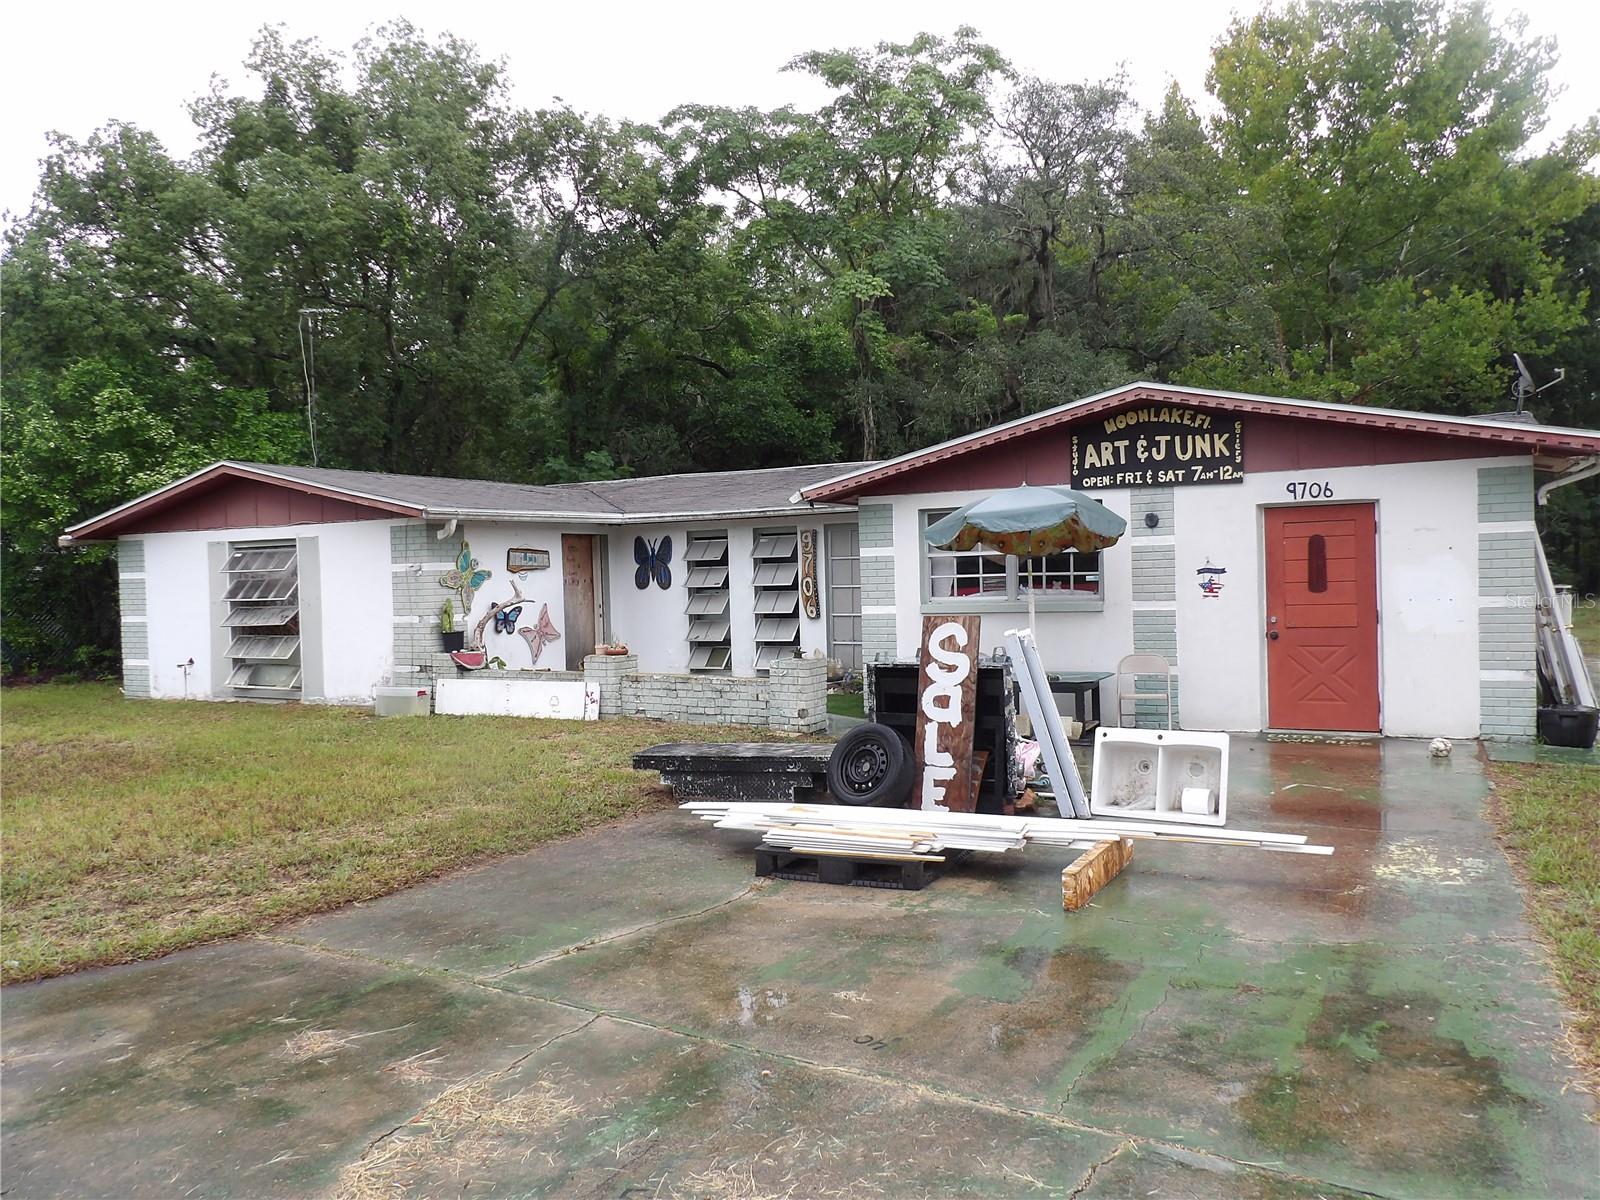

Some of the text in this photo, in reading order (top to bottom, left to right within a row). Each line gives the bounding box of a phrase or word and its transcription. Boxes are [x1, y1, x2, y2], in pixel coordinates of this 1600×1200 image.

[1071, 435, 1079, 476] Studio
[1084, 439, 1130, 469] ART
[1151, 433, 1230, 461] JUNK
[1082, 475, 1114, 487] OPEN:
[1116, 471, 1143, 485] FRI
[1146, 469, 1153, 484] &
[1157, 469, 1186, 483] SAT
[1286, 481, 1334, 500] 9706
[801, 530, 817, 618] 9706
